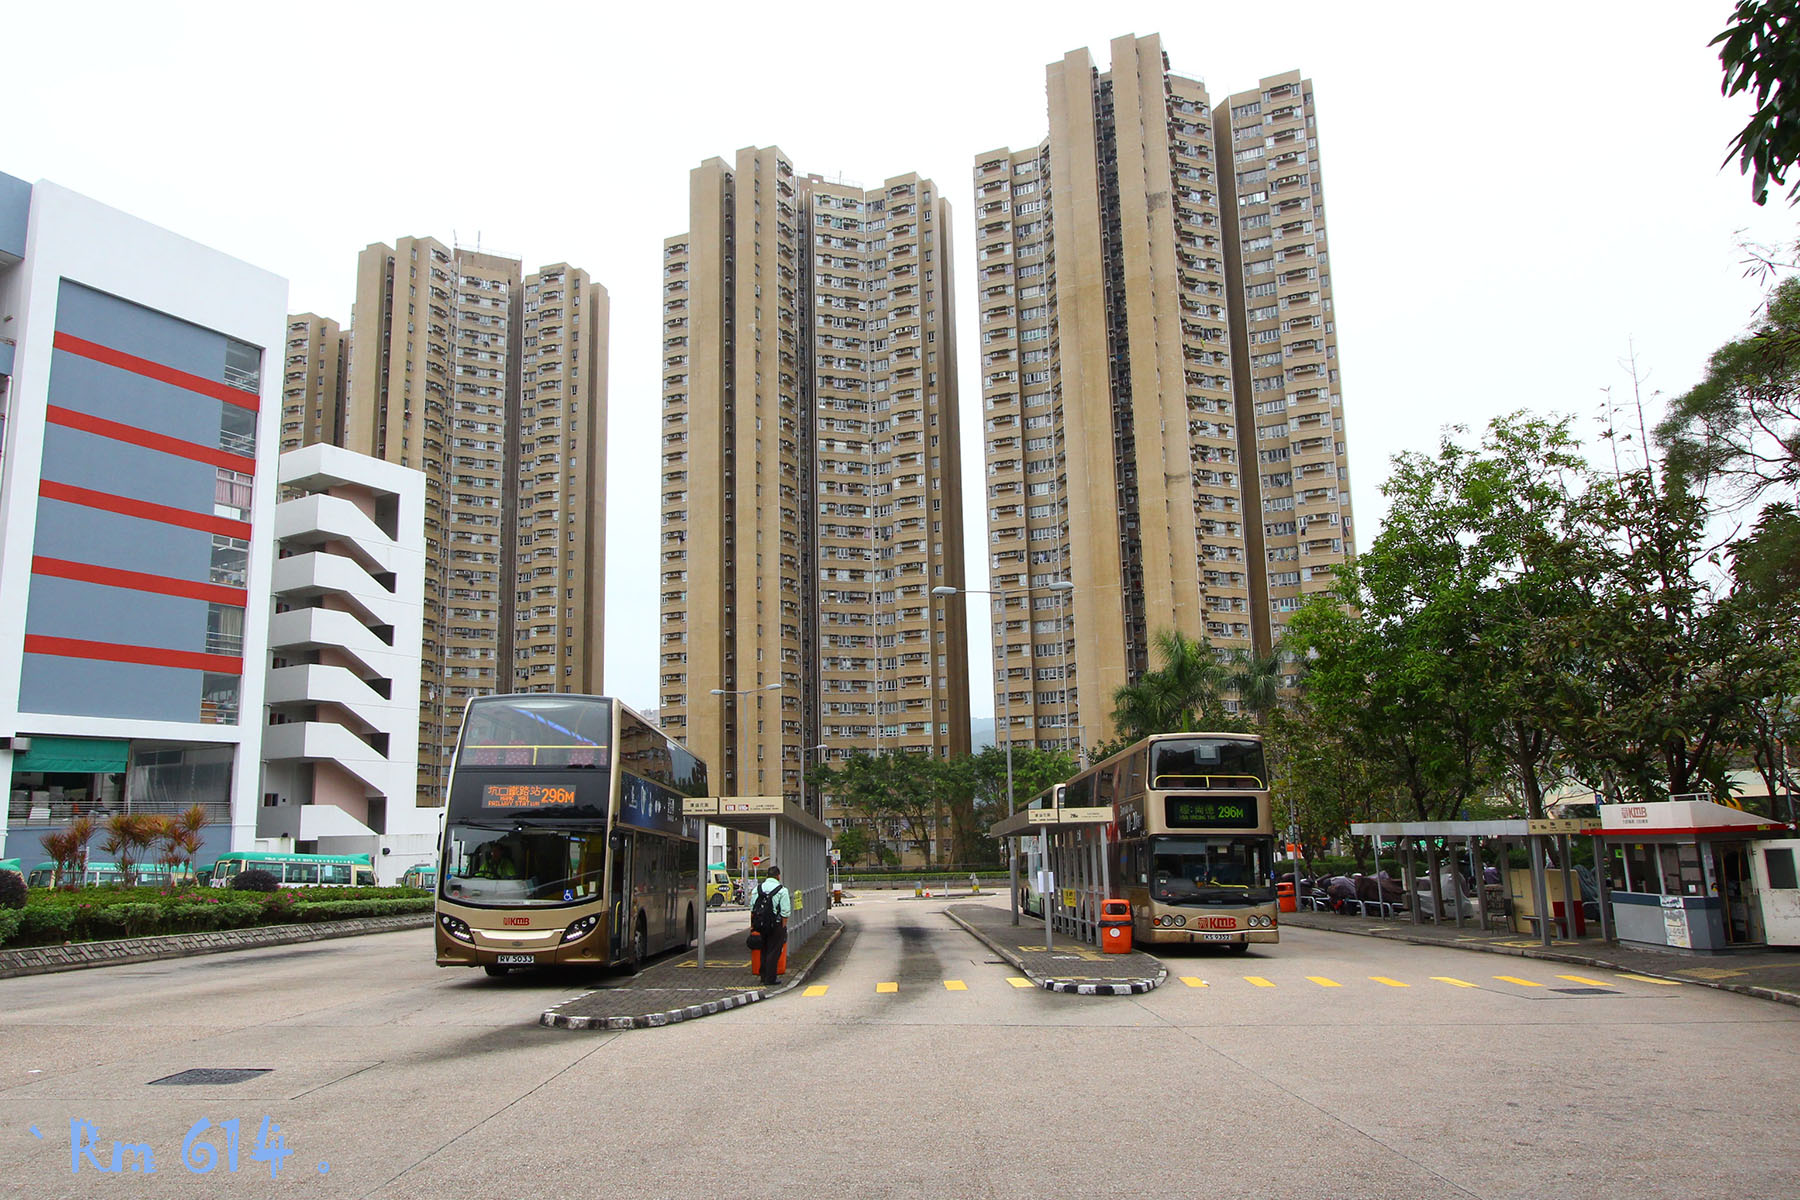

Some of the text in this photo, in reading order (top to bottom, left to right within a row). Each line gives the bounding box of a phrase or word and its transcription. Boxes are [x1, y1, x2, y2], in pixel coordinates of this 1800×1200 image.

[541, 788, 575, 803] 296M
[1217, 805, 1244, 819] 296M
[1628, 806, 1648, 819] KMB
[510, 917, 530, 926] KMB
[1209, 917, 1237, 929] KMB
